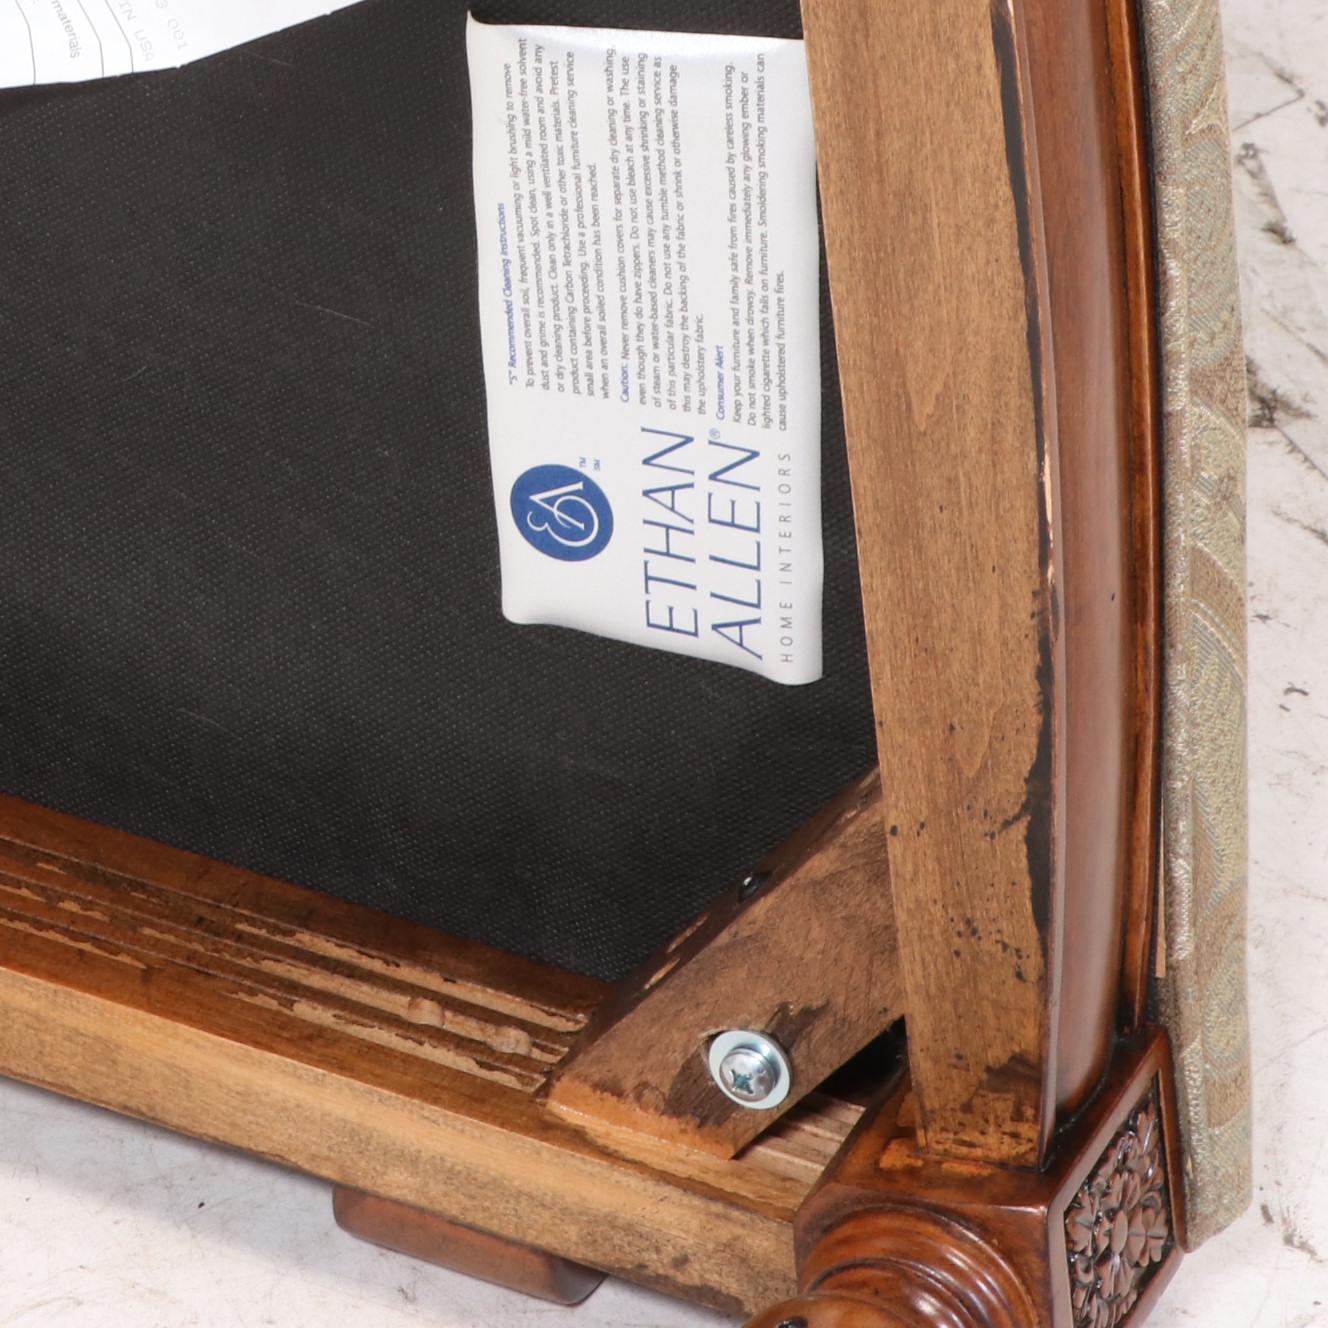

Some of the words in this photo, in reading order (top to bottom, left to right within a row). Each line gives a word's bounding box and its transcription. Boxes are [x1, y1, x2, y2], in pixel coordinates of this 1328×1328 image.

[50, 0, 82, 59] materials
[503, 62, 513, 99] remove
[740, 71, 749, 84] or
[505, 100, 515, 112] to
[606, 95, 615, 107] or
[738, 85, 750, 120] ember
[505, 113, 518, 155] brushing
[607, 107, 618, 147] cleaning
[723, 111, 735, 151] careless
[739, 121, 753, 163] glowing
[508, 156, 522, 179] light
[608, 147, 622, 165] dry
[724, 151, 738, 165] by
[742, 163, 753, 183] any
[512, 180, 521, 192] or
[610, 164, 624, 206] separate
[725, 165, 737, 201] caused
[496, 202, 509, 257] Instructions
[513, 192, 525, 244] vacuuming
[612, 207, 623, 222] for
[726, 202, 738, 224] fires
[741, 183, 754, 245] immediately
[615, 223, 625, 254] covers
[727, 225, 739, 250] from
[501, 257, 513, 298] Cleaning
[516, 244, 530, 284] frequent
[615, 255, 628, 294] cushion
[727, 251, 739, 273] safe
[743, 245, 754, 286] Remove
[728, 273, 742, 305] family
[520, 306, 533, 340] overall
[619, 294, 629, 331] remove
[729, 306, 741, 327] and
[774, 296, 786, 341] furniture
[502, 298, 517, 369] Recommended
[620, 331, 631, 361] Never
[730, 328, 741, 372] furniture
[745, 327, 756, 356] when
[523, 340, 537, 377] prevent
[714, 344, 725, 370] Alert
[745, 357, 757, 390] smoke
[774, 342, 789, 402] upholstered
[524, 377, 536, 388] To
[619, 362, 630, 404] Caution:
[715, 370, 726, 421] Consumer
[733, 373, 744, 398] your
[732, 398, 744, 424] Keep
[747, 391, 757, 410] not
[778, 403, 787, 432] cause
[746, 411, 757, 427] Do
[640, 426, 700, 639] ETHAN
[777, 454, 792, 584] INTERIORS
[778, 602, 794, 663] HOME
